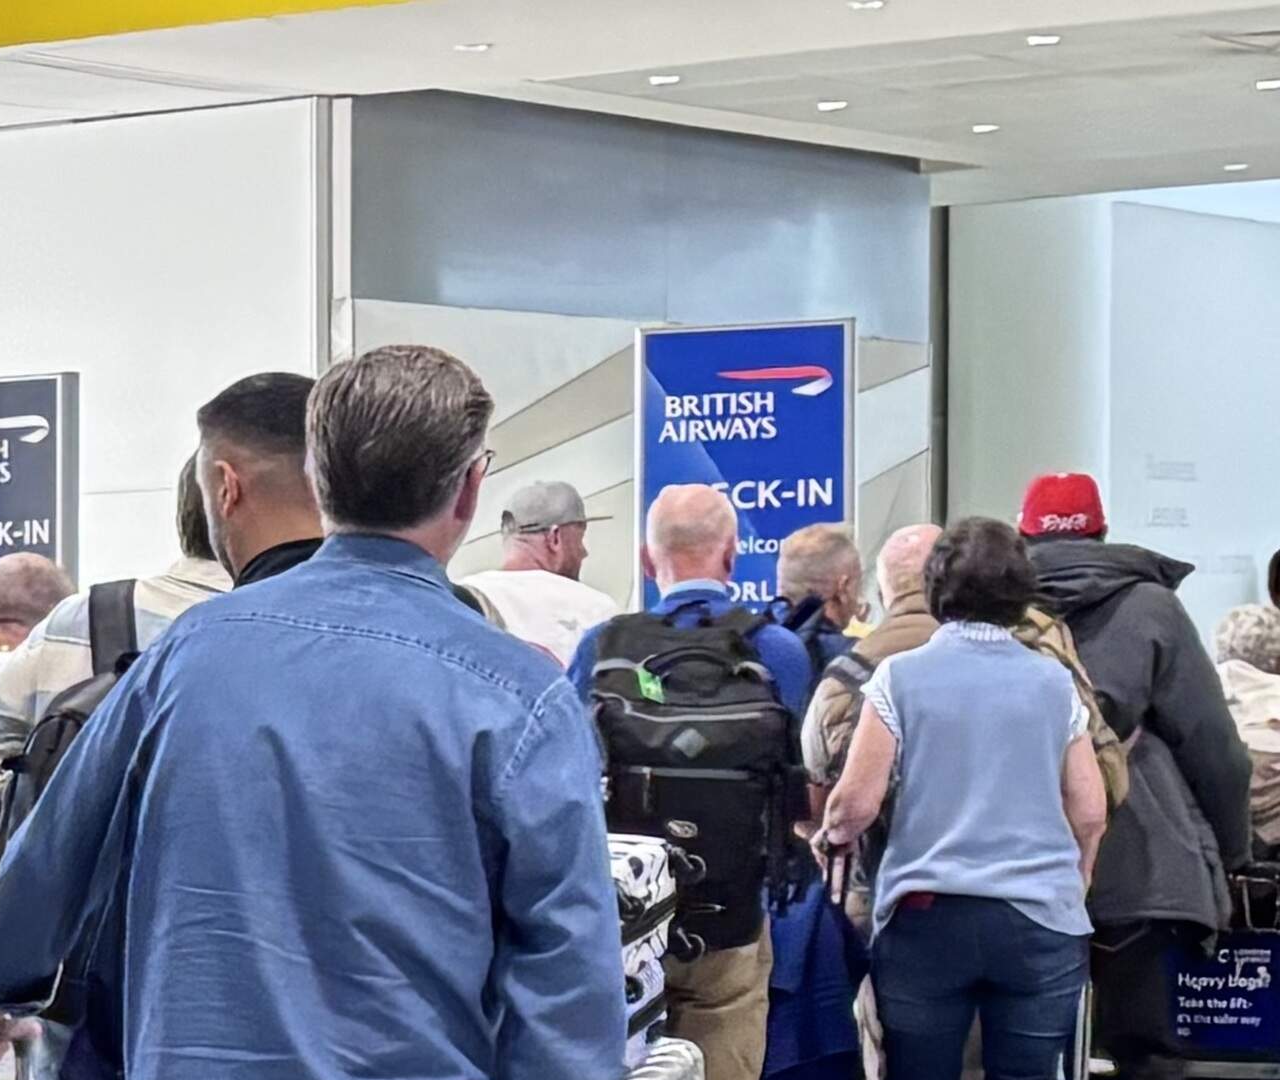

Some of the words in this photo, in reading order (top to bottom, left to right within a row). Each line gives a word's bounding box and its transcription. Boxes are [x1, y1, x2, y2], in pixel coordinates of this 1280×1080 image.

[665, 391, 774, 418] BRITISH
[658, 416, 777, 443] AIRWAYS
[711, 478, 833, 510] CK-IN
[736, 536, 778, 555] elco
[726, 580, 775, 602] ORL
[1178, 973, 1225, 991] Heavy
